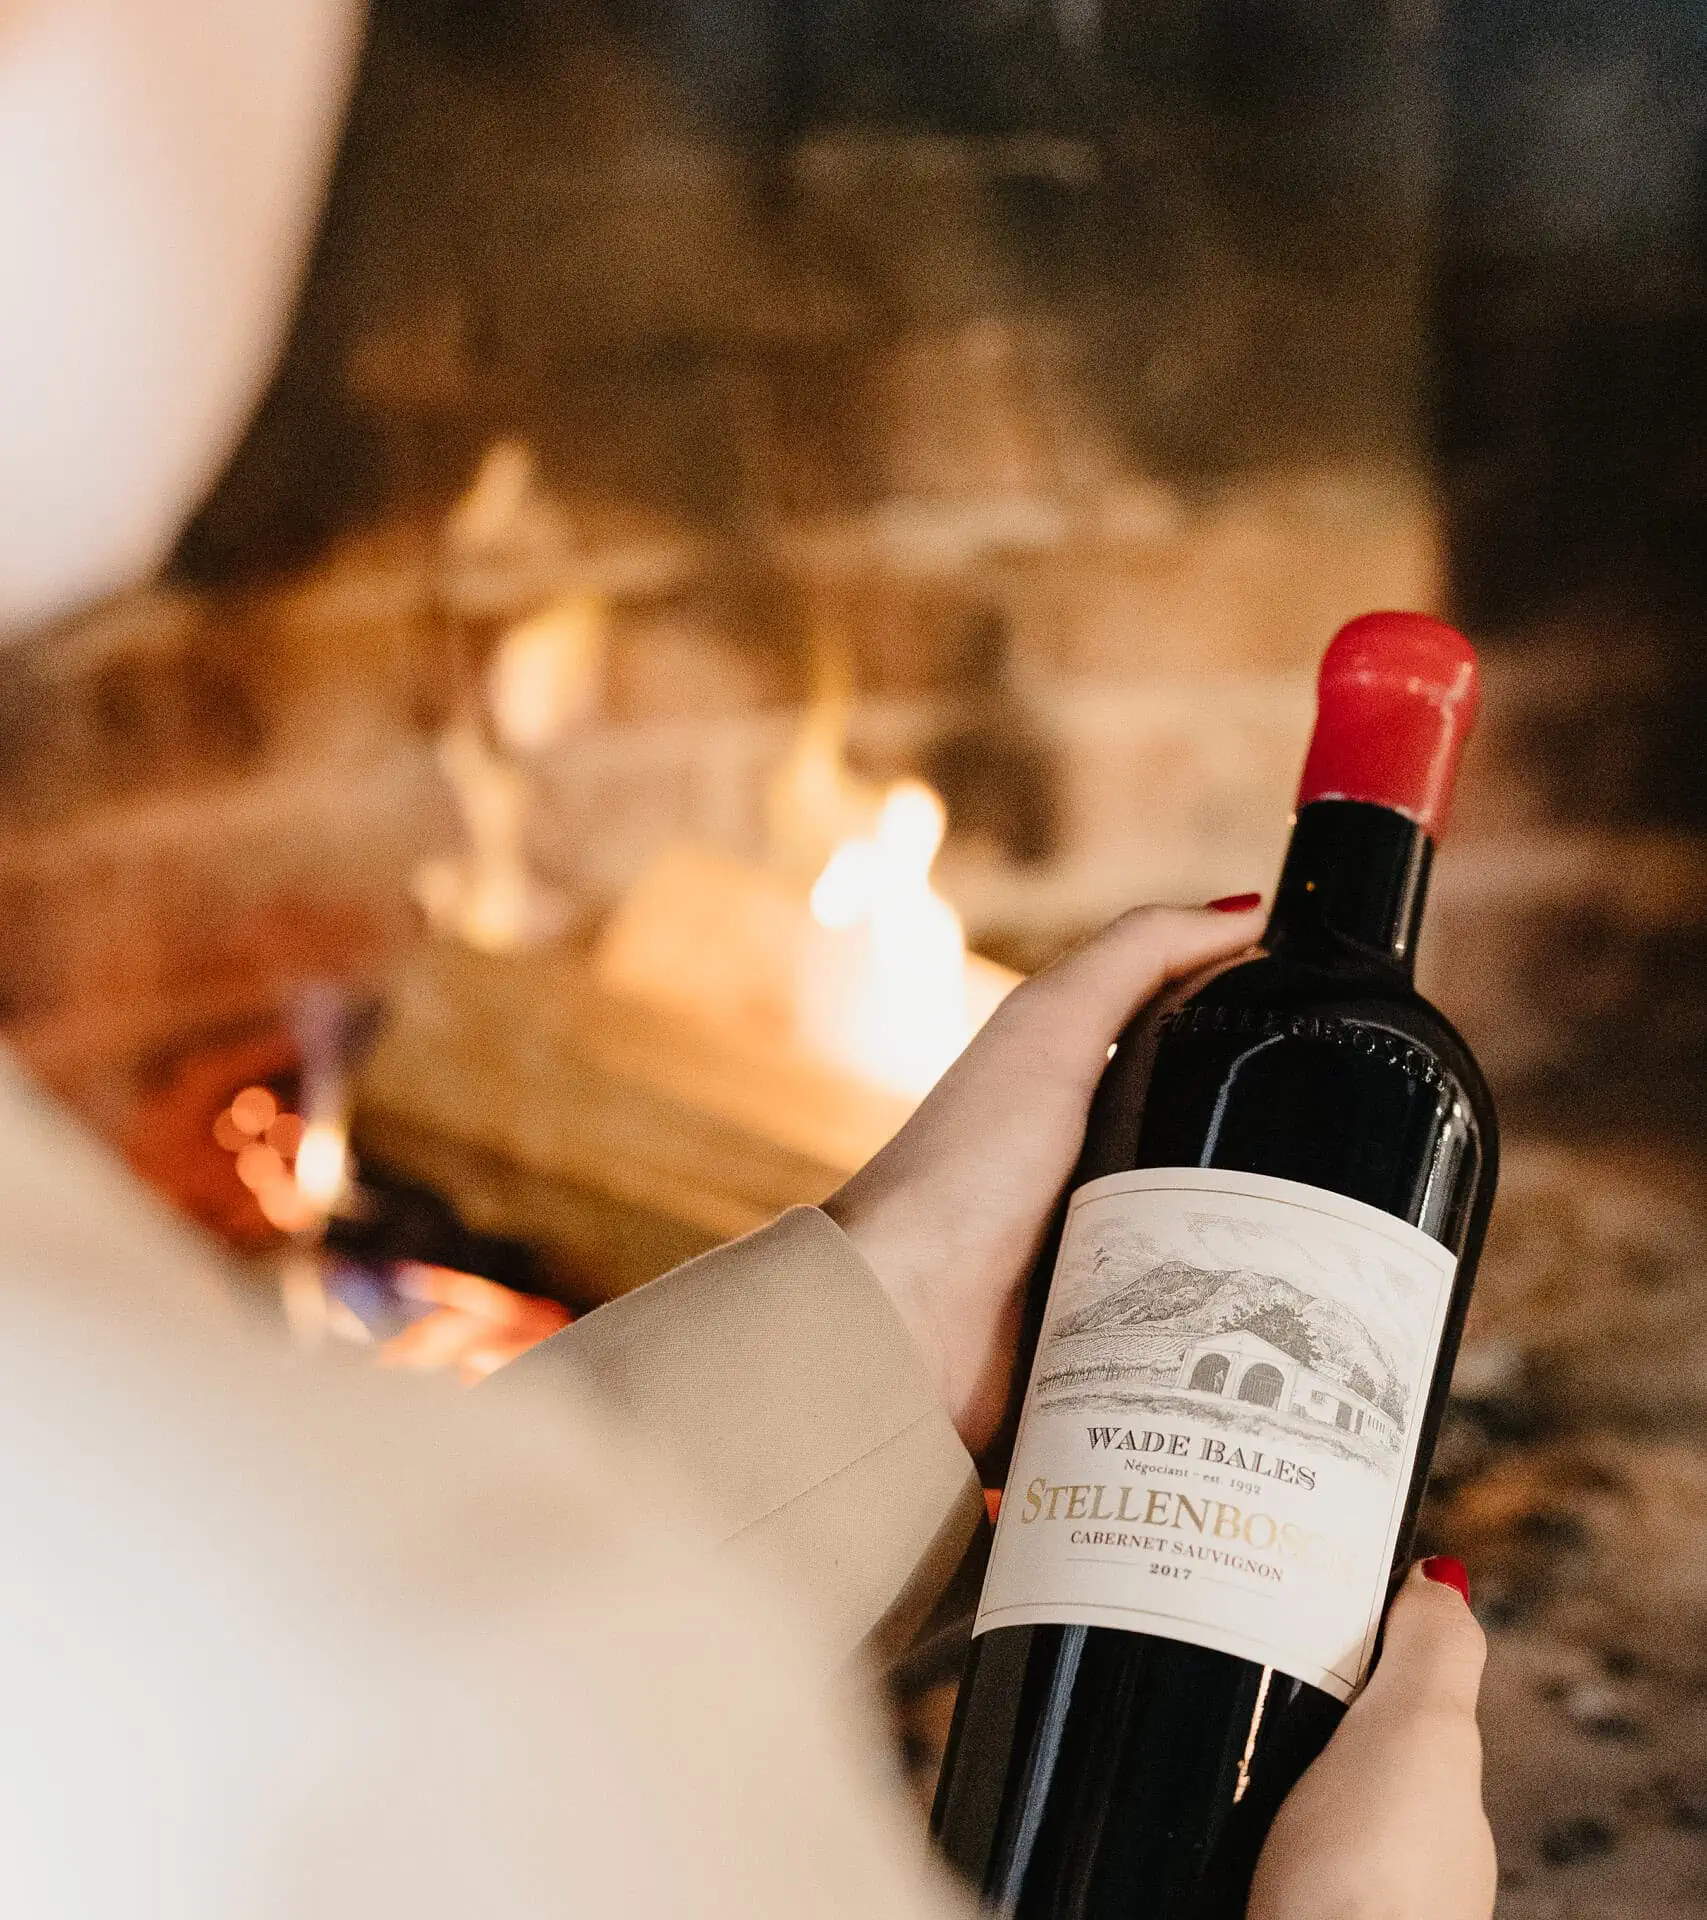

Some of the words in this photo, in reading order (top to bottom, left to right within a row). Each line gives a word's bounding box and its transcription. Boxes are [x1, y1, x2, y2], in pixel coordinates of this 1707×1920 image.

[1087, 1427, 1191, 1458] WADE
[1199, 1438, 1317, 1492] BALES
[1124, 1459, 1188, 1479] Négociant
[1230, 1479, 1261, 1496] 1992
[1070, 1530, 1168, 1554] CABERNET
[1172, 1541, 1284, 1582] SAUVIGNON
[1149, 1563, 1192, 1580] 2017
